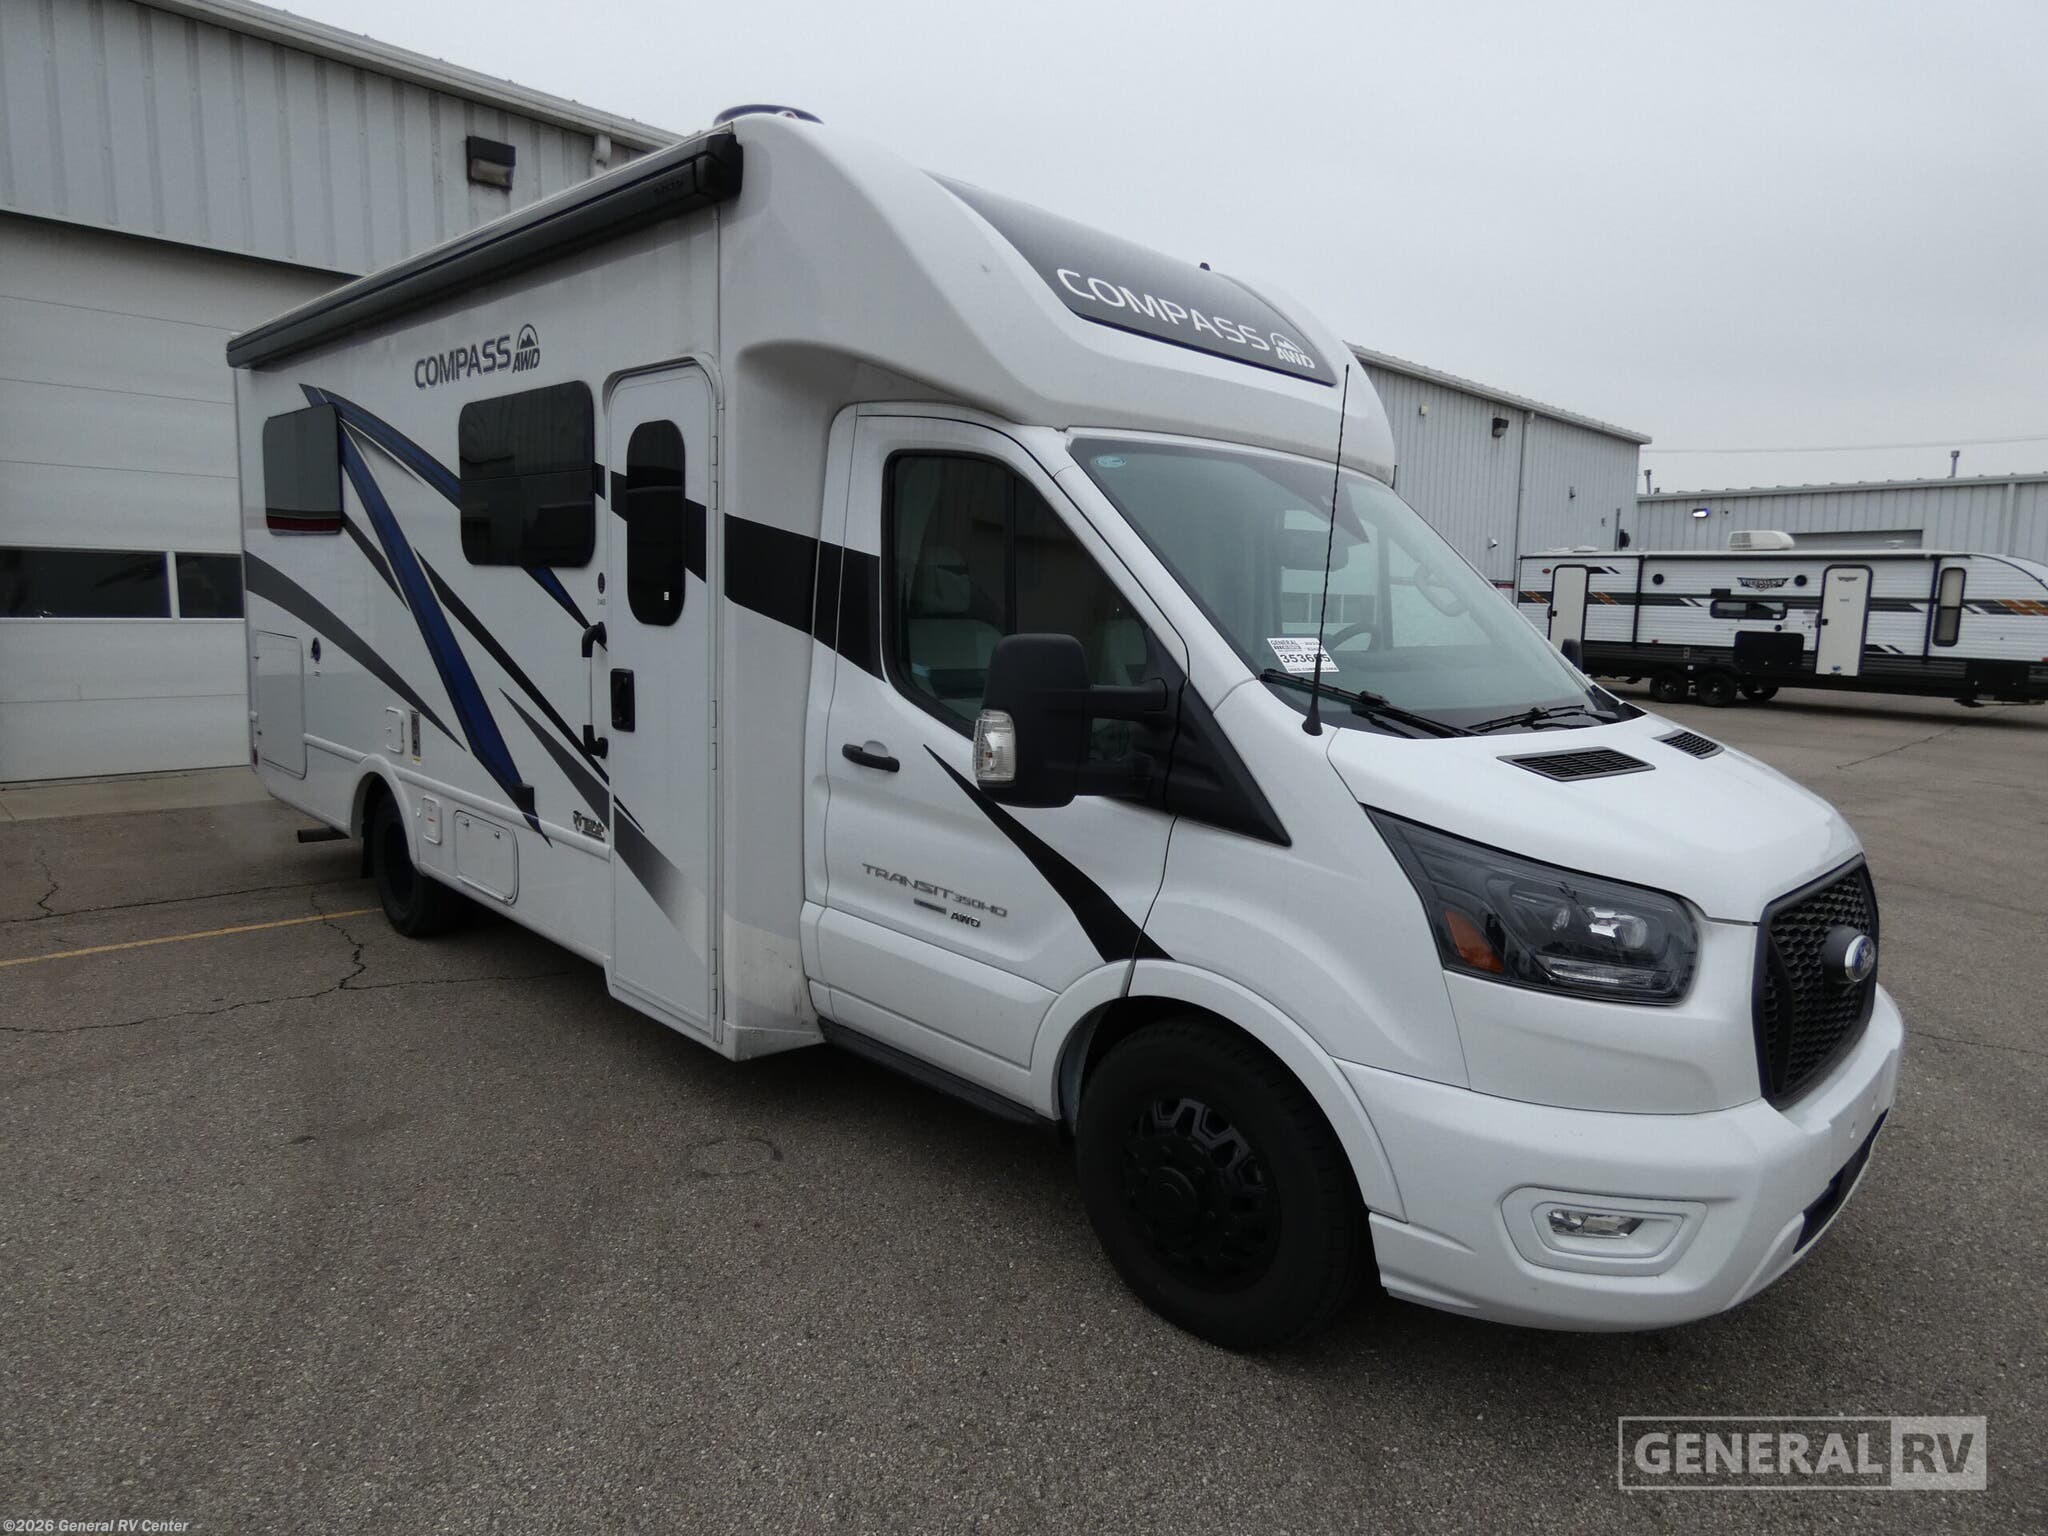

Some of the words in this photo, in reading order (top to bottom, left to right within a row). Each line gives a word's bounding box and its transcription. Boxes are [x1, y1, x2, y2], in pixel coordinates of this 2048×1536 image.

[1056, 268, 1270, 351] COMPASS
[1276, 348, 1315, 369] AWD
[414, 335, 512, 389] COMPASS
[512, 347, 540, 373] AWD
[1279, 653, 1331, 663] 35365
[950, 911, 982, 928] AWD
